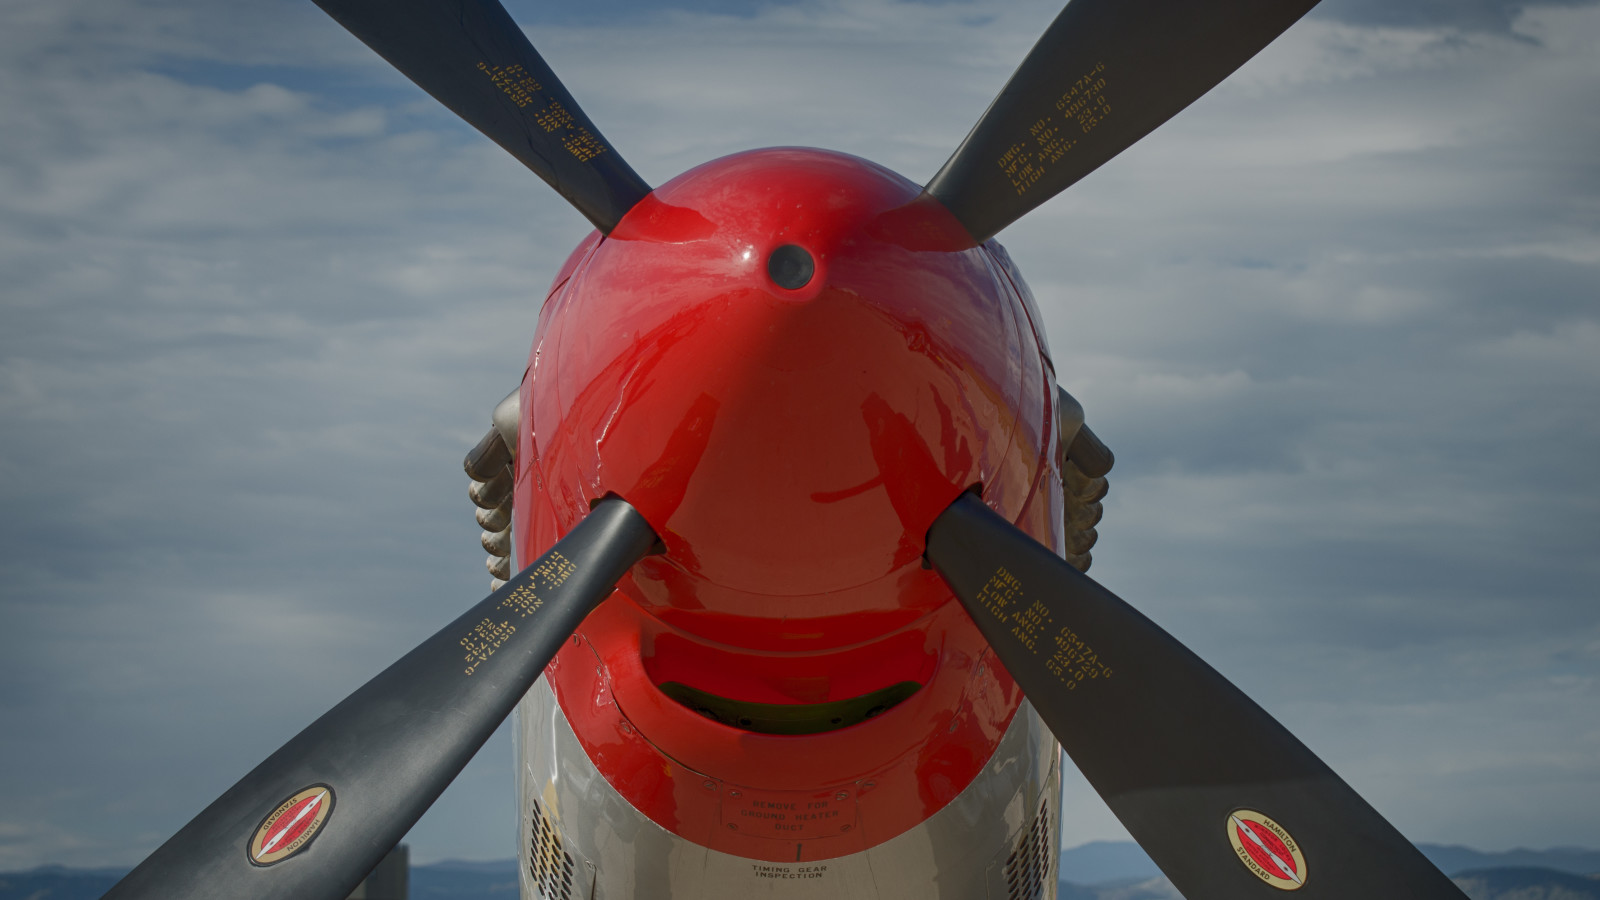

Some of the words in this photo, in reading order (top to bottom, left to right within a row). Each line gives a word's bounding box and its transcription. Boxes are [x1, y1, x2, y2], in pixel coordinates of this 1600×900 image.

[534, 113, 554, 133] NO.
[542, 109, 561, 128] NO.
[549, 105, 574, 129] ANG.
[562, 137, 589, 162] DWG.
[569, 134, 596, 158] MFG.
[578, 135, 602, 154] LOW
[998, 142, 1025, 168] DWG.
[1029, 117, 1051, 136] NO.
[1005, 152, 1032, 178] MFG.
[1037, 127, 1059, 146] NO.
[1012, 164, 1033, 187] LOW
[1038, 137, 1064, 162] ANG.
[1017, 166, 1045, 195] HIGH
[1051, 139, 1077, 164] ANG.
[529, 551, 559, 580] HIGH
[542, 554, 564, 577] LOW
[542, 558, 570, 585] MFG.
[549, 563, 577, 590] DWG.
[496, 585, 524, 610] ANG.
[509, 582, 536, 607] ANG.
[514, 593, 536, 612] NO.
[521, 598, 544, 618] NO.
[989, 575, 1016, 604] MFG.
[1024, 607, 1045, 631] NO.
[996, 567, 1024, 596] DWG.
[1032, 599, 1053, 623] NO.
[976, 592, 1008, 623] HIGH
[1011, 626, 1037, 655] ANG.
[983, 584, 1008, 608] LOW
[1011, 611, 1038, 639] ANG.
[264, 798, 297, 830] STANDARD
[741, 810, 785, 820] GROUND
[795, 810, 839, 820] HEATER
[753, 800, 796, 810] REMOVE
[808, 801, 828, 809] FOR
[287, 819, 320, 851] HAMILTON
[1264, 820, 1296, 852] HAMILTON
[1237, 847, 1270, 880] STANDARD
